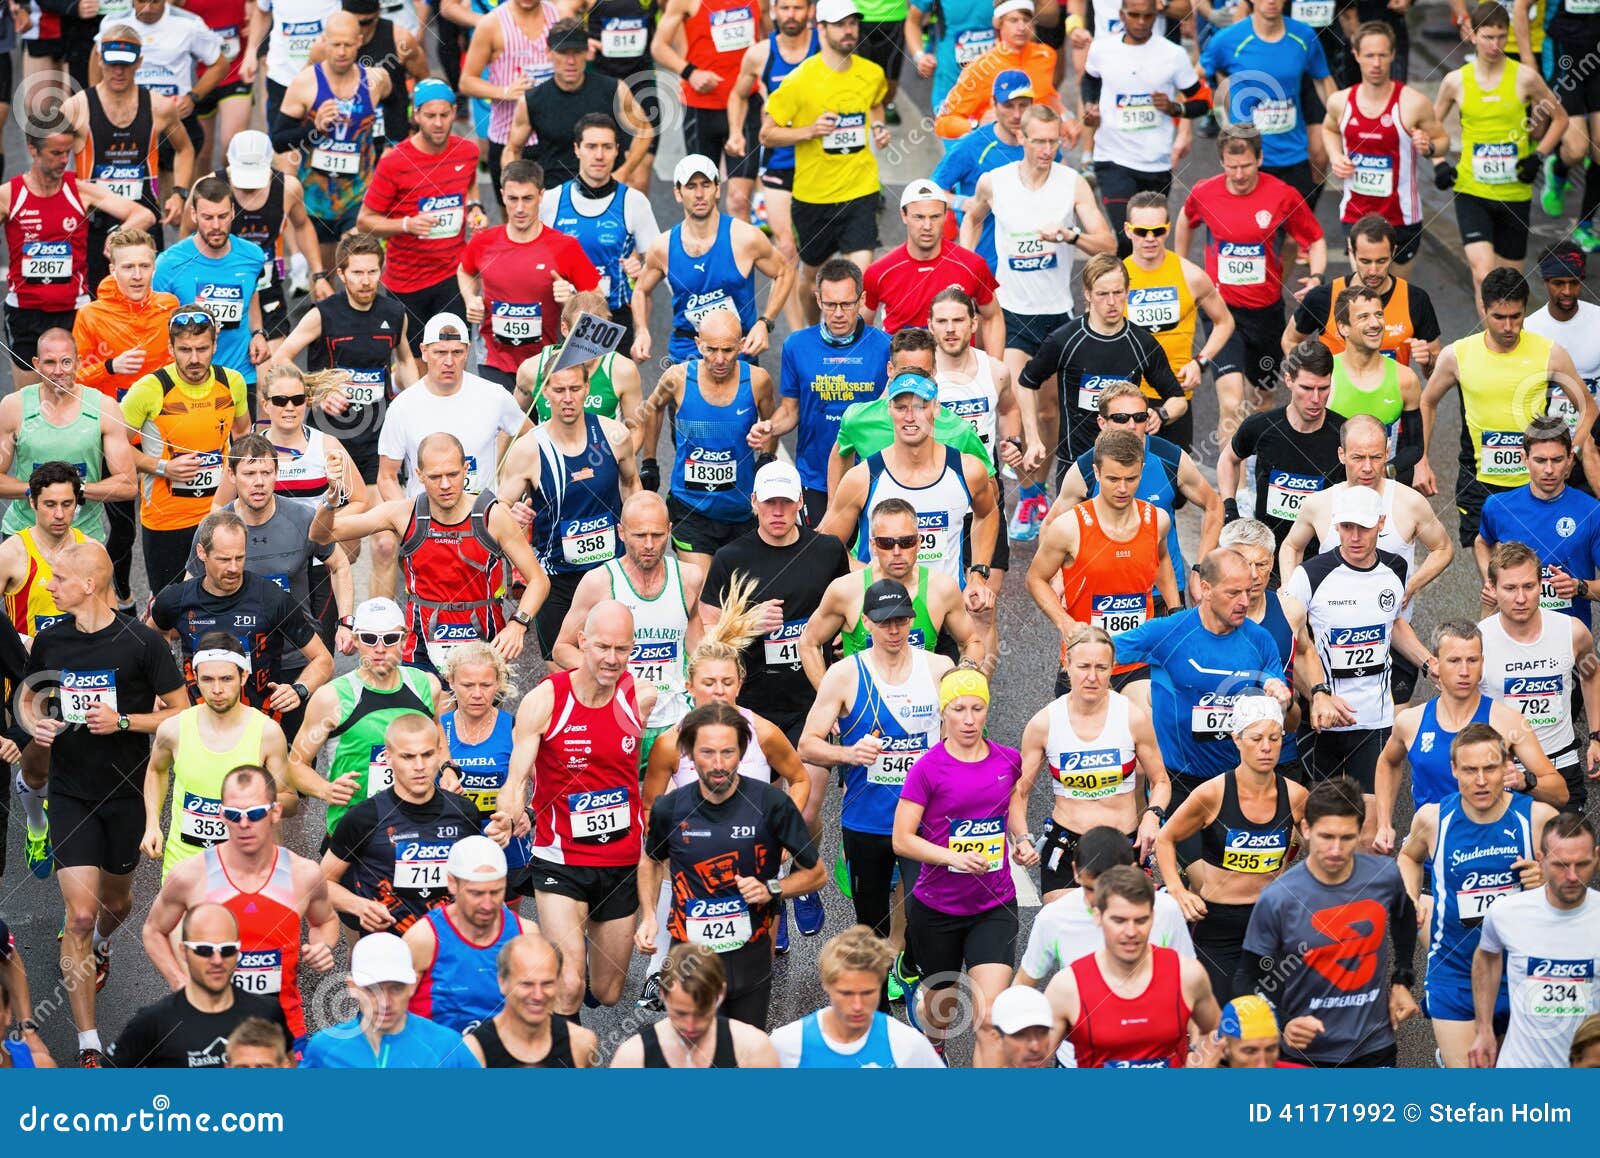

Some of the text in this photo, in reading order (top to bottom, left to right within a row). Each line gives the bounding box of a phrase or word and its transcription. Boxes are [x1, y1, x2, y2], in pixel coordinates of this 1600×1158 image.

[1300, 6, 1328, 16] 1673
[723, 27, 745, 40] 532
[613, 35, 637, 47] 814
[1122, 110, 1155, 123] 5180
[834, 133, 857, 145] 584
[331, 142, 357, 152] asics
[323, 156, 347, 170] 311
[1483, 162, 1506, 174] 631
[112, 167, 140, 178] asics
[1354, 171, 1385, 185] 1627
[40, 244, 67, 256] asics
[1018, 240, 1043, 255] 522
[1233, 244, 1261, 256] asics
[29, 260, 65, 275] 2867
[1228, 261, 1253, 274] 609
[211, 285, 241, 298] asics
[699, 289, 725, 305] asics
[1145, 290, 1175, 301] asics
[508, 303, 538, 316] asics
[1136, 306, 1172, 323] 3305
[503, 321, 530, 335] 459
[575, 316, 619, 348] 3:00
[354, 370, 381, 382] asics
[810, 382, 875, 393] FREDERIKSBERG
[956, 400, 984, 414] asics
[1501, 433, 1524, 446] asic
[703, 449, 731, 462] asics
[1494, 450, 1522, 466] 605
[688, 464, 734, 481] 18308
[1287, 475, 1320, 490] asics
[580, 516, 609, 531] asics
[577, 535, 606, 555] 358
[1111, 596, 1142, 610] asics
[784, 622, 808, 637] asic
[1100, 614, 1139, 632] 1866
[1351, 628, 1379, 642] asics
[640, 646, 673, 660] asics
[1344, 647, 1375, 666] 722
[1505, 659, 1547, 672] CRAFT
[75, 674, 109, 688] asics
[634, 666, 662, 683] 741
[1525, 679, 1558, 693] asics
[912, 704, 933, 713] TJALVE
[1519, 699, 1551, 716] 792
[571, 723, 588, 732] asics
[891, 735, 922, 750] asics
[458, 757, 497, 767] UMBA
[882, 755, 915, 773] 546
[1080, 752, 1115, 768] asics
[465, 776, 498, 788] asics
[1063, 774, 1098, 791] 230
[592, 791, 624, 808] asics
[194, 819, 226, 836] 353
[586, 814, 617, 833] 531
[971, 820, 1001, 834] asics
[1248, 833, 1280, 848] asics
[417, 844, 450, 859] asics
[1451, 844, 1519, 866] Studenterna
[1227, 852, 1260, 869] 255
[410, 866, 441, 884] 714
[1478, 871, 1513, 886] asics
[707, 899, 741, 914] asics
[702, 920, 736, 939] 424
[241, 953, 277, 967] asics
[1546, 962, 1587, 977] asics
[232, 974, 267, 992] 616
[1542, 984, 1578, 1003] 334
